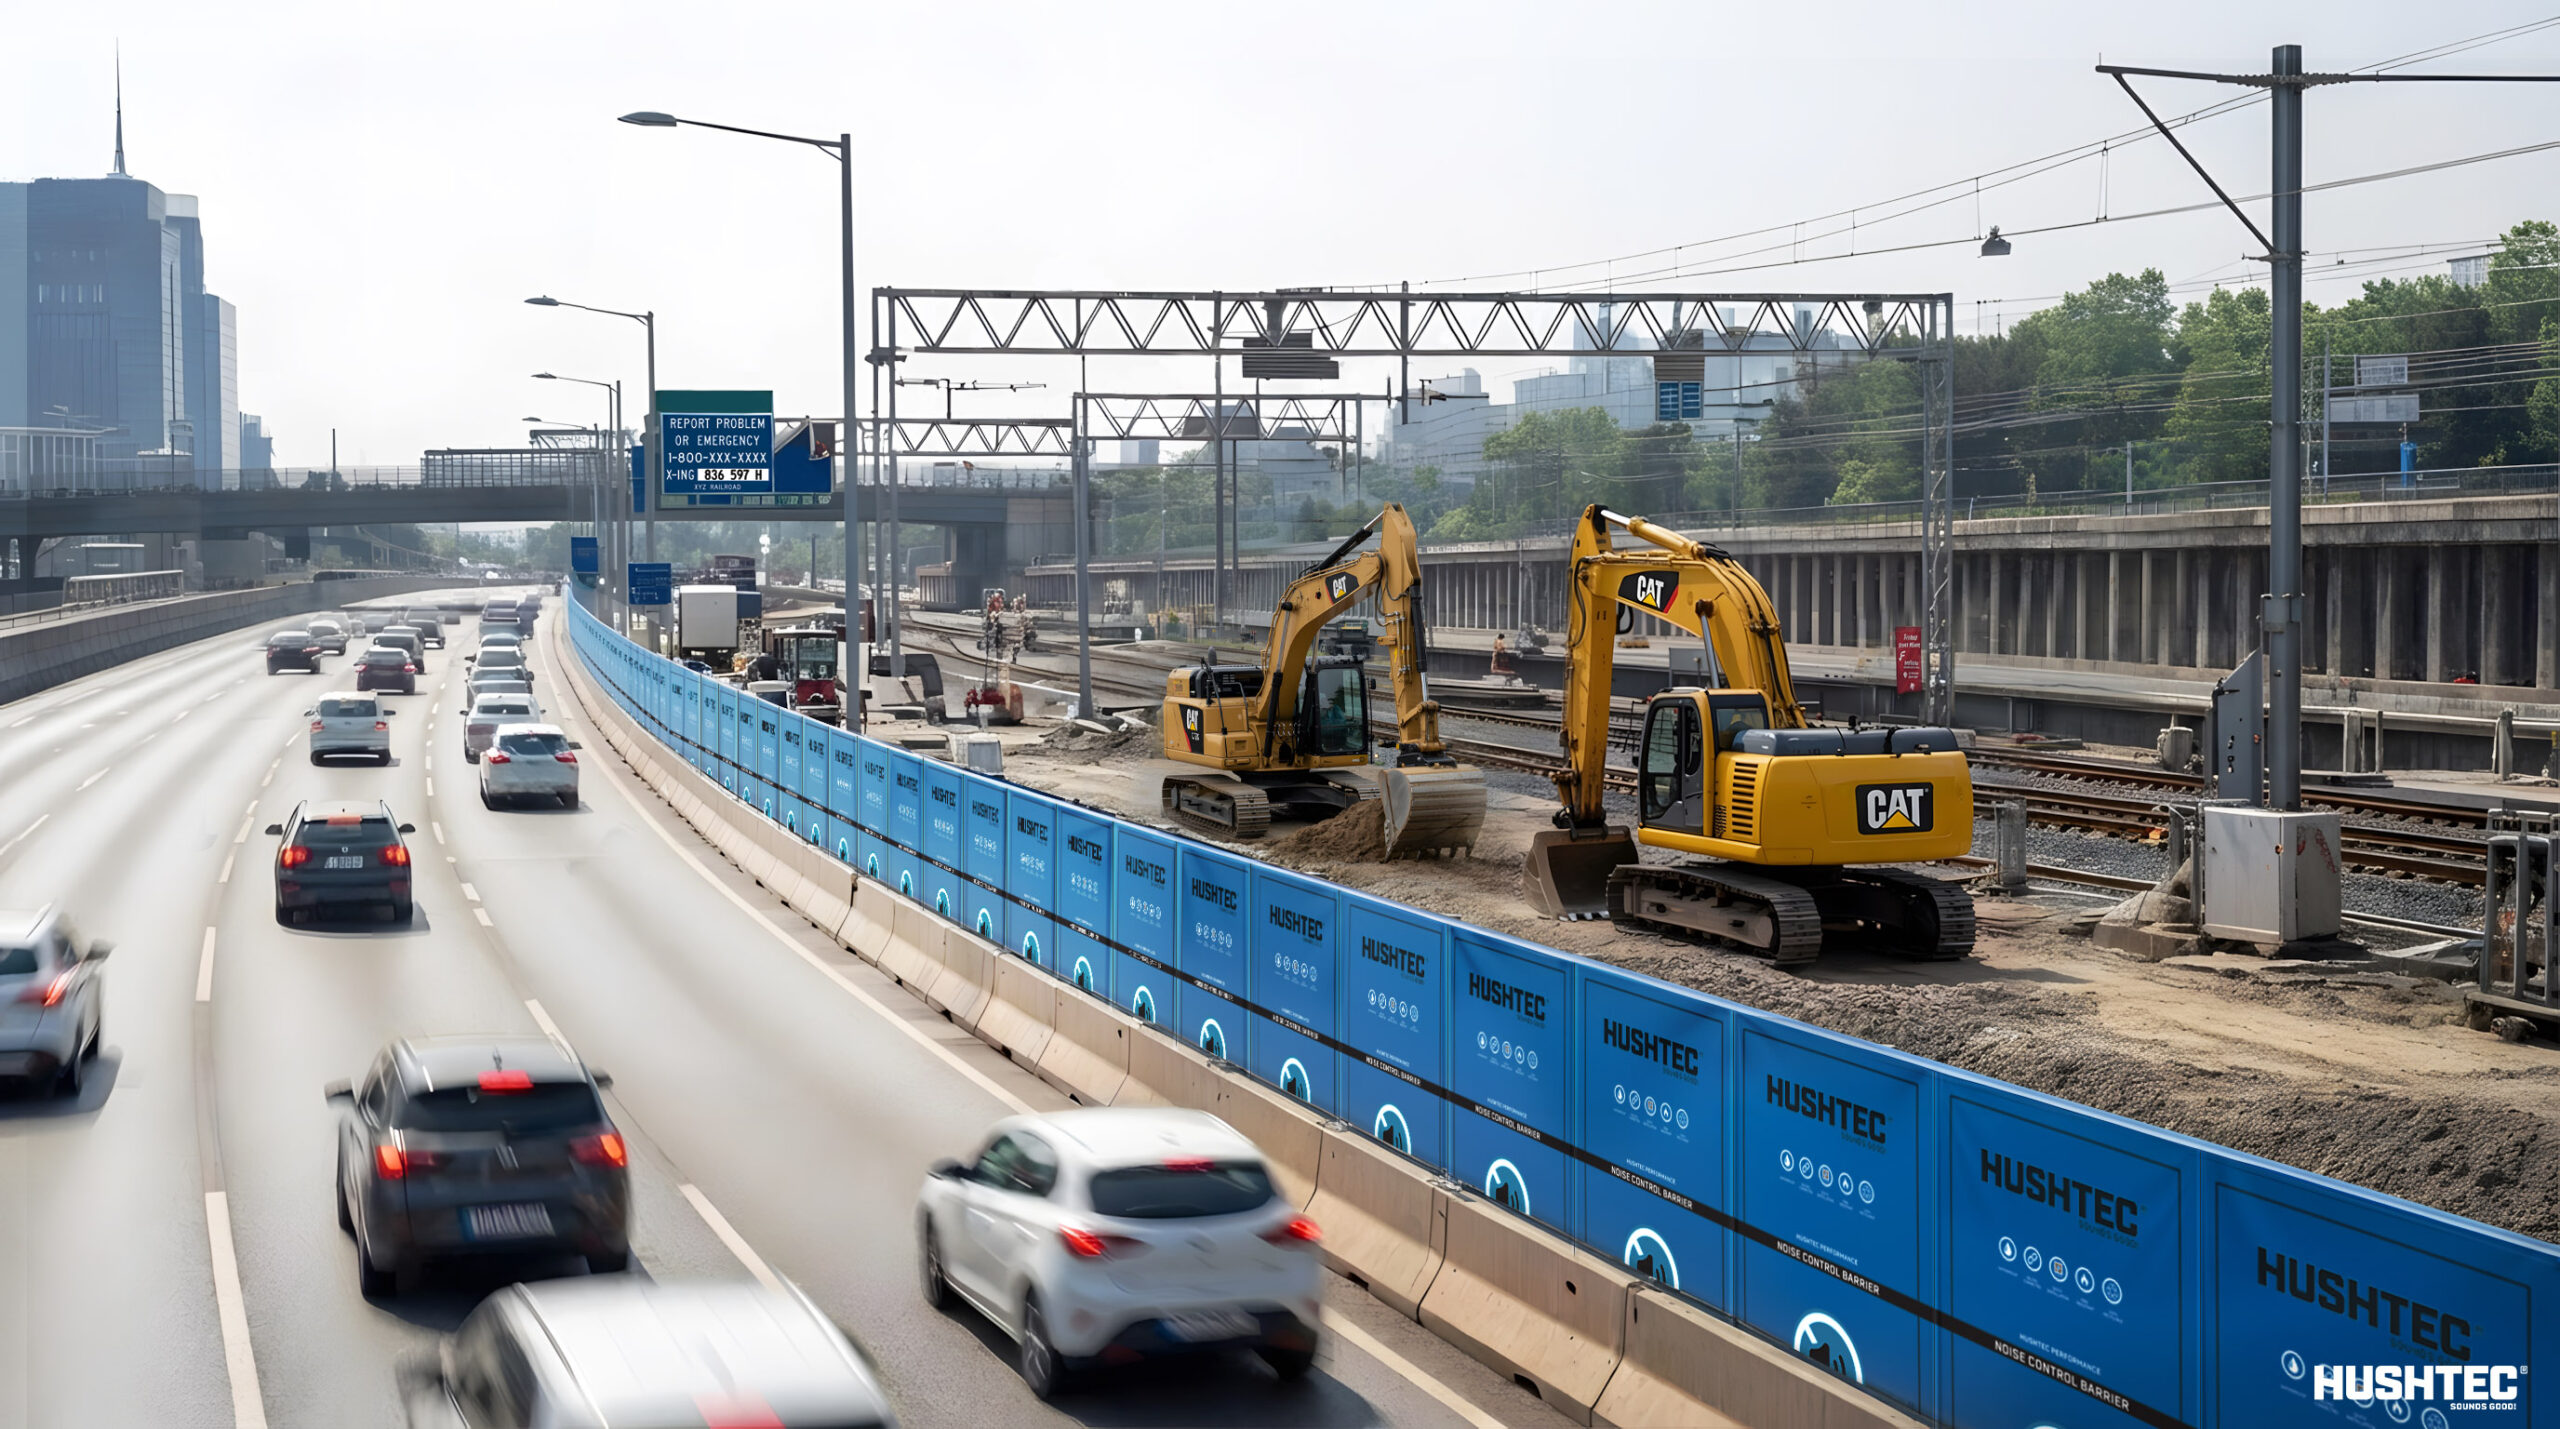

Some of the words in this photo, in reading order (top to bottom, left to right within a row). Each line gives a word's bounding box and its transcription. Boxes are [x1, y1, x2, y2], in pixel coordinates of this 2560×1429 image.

[670, 418, 710, 429] REPORT
[716, 418, 765, 429] PROBLEM
[675, 435, 689, 446] OR
[697, 435, 760, 446] EMERGENCY
[666, 469, 695, 480] X-ING
[704, 469, 724, 480] 836
[730, 469, 750, 480] 597
[755, 469, 762, 480] H
[668, 452, 767, 463] 1-800-XXX-XXXX
[1333, 575, 1346, 599] CAT
[1637, 575, 1664, 609] CAT
[1186, 708, 1199, 731] CAT
[1867, 788, 1924, 829] CAT
[1017, 816, 1048, 841] HUSHTEC
[1067, 834, 1102, 861] HUSHTEC
[1125, 854, 1166, 885] HUSHTEC
[1191, 877, 1237, 911] HUSHTEC
[1269, 904, 1323, 942] HUSHTEC
[1361, 935, 1425, 978] HUSHTEC
[1469, 972, 1545, 1021] HUSHTEC
[1604, 1018, 1698, 1076] HUSHTEC
[1767, 1074, 1886, 1144] HUSHTEC
[1611, 1165, 1630, 1182] NOISE
[1631, 1175, 1662, 1196] CONTROL
[1662, 1188, 1693, 1210] BARRIER
[1981, 1148, 2137, 1236] HUSHTEC
[1777, 1240, 1801, 1260] NOISE
[1802, 1252, 1840, 1278] CONTROL
[1842, 1269, 1880, 1295] BARRIER
[1796, 1233, 1819, 1249] HUSHTEC
[1819, 1243, 1858, 1266] PERFORMANCE
[2257, 1246, 2470, 1361] HUSHTEC
[2019, 1333, 2050, 1353] HUSHTEC
[2050, 1346, 2101, 1376] PERFORMANCE
[1994, 1340, 2026, 1364] NOISE
[2027, 1355, 2078, 1388] CONTROL
[2080, 1379, 2130, 1412] BARRIER
